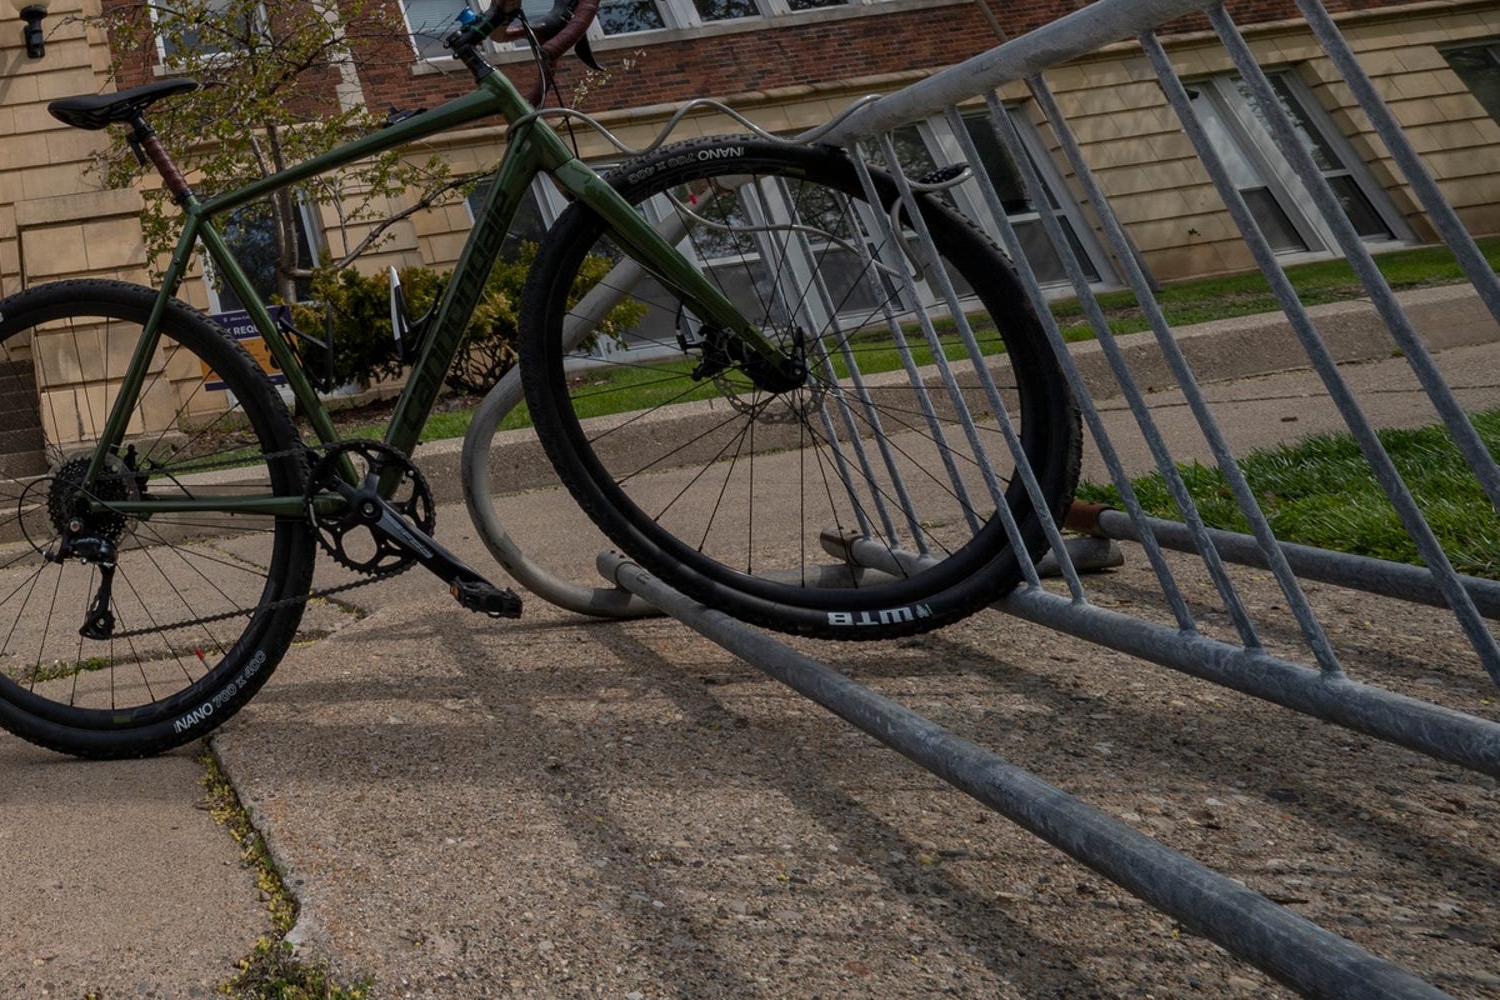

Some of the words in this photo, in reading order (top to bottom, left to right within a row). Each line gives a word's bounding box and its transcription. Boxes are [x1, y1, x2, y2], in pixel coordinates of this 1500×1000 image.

[698, 147, 741, 161] NANO
[827, 607, 914, 626] WTB
[175, 703, 213, 733] NANO
